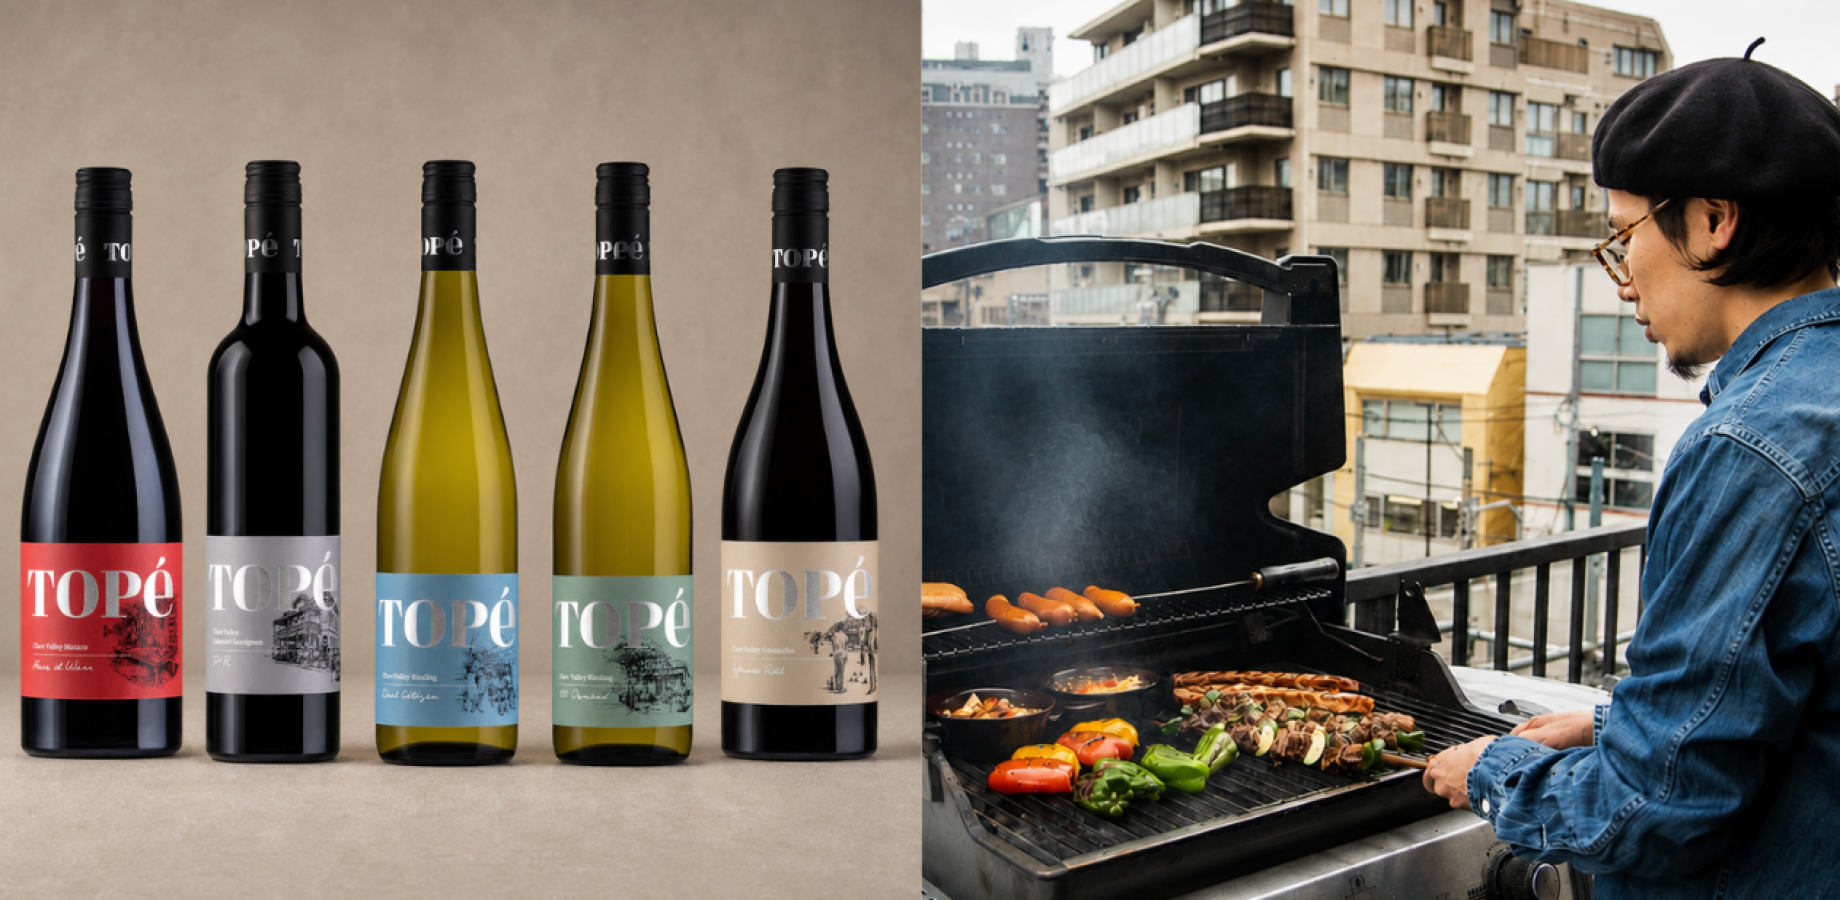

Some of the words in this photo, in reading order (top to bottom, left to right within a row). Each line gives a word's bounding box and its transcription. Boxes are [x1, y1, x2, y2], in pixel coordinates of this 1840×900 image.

[28, 556, 174, 619] TOPé
[209, 550, 338, 613] TOPé
[727, 555, 872, 620] TOPé
[45, 643, 63, 652] Valley
[64, 643, 88, 651] Mataro
[378, 586, 516, 648] TOPé
[555, 587, 690, 648] TOPé
[393, 673, 410, 683] Valley
[411, 673, 438, 683] Riesling
[587, 674, 613, 683] Riesling
[762, 646, 795, 655] Grenache
